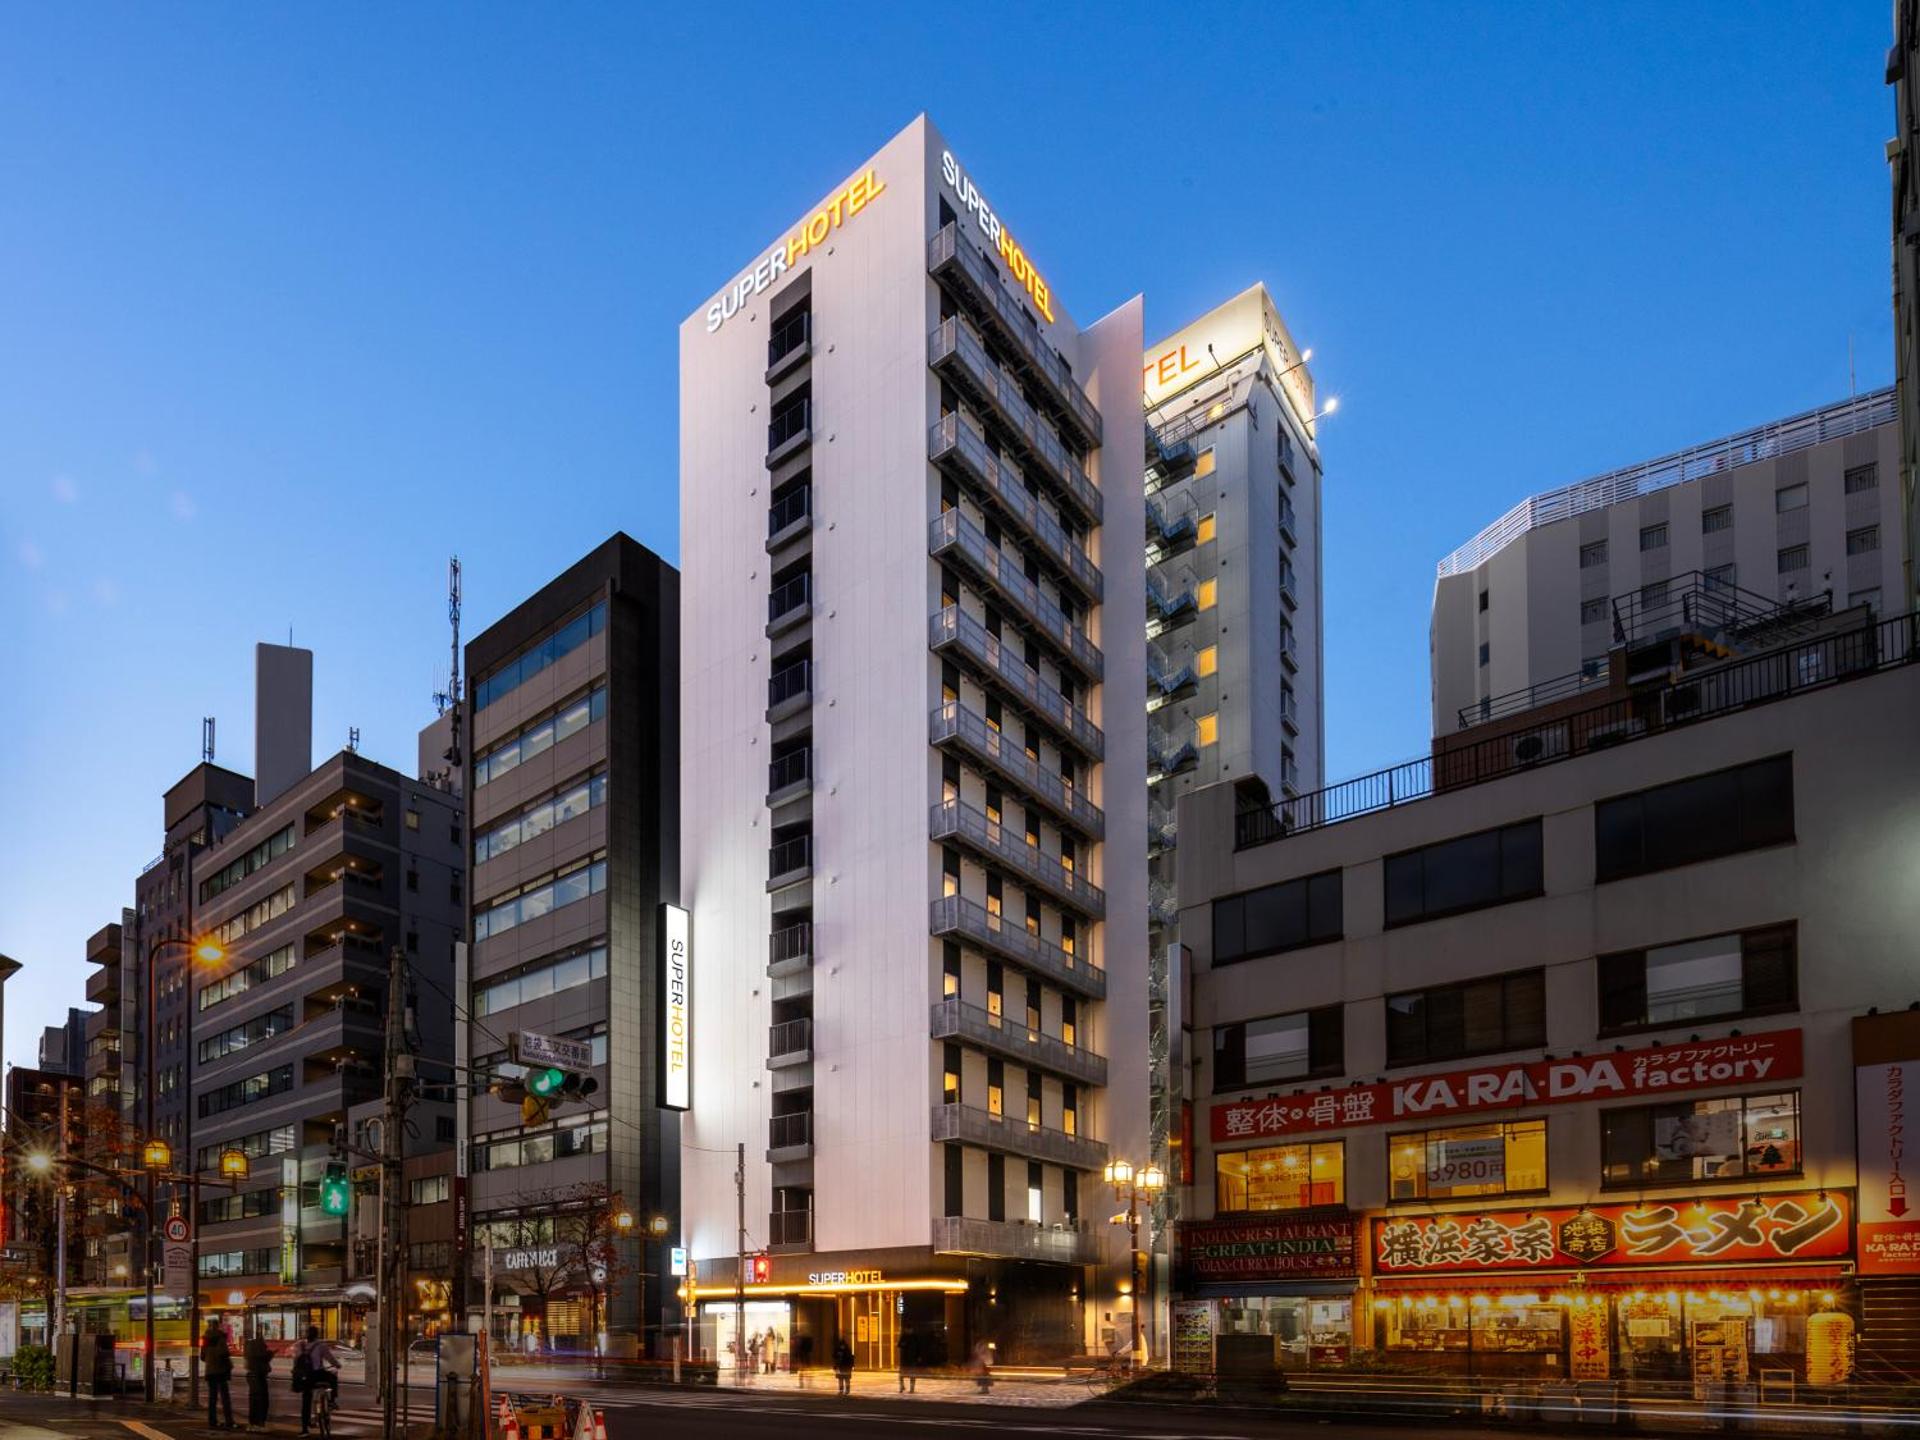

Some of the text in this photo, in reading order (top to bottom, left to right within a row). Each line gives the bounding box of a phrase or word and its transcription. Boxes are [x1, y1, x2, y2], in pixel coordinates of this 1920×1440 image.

[706, 168, 886, 333] SUPERHOTEL
[942, 150, 1055, 324] SUPERHOTEL
[671, 938, 684, 1073] SUPERHOTEL
[1632, 1056, 1775, 1090] factory
[171, 1223, 185, 1236] 40
[1379, 1199, 1843, 1269] 横浜家系 ラーメン
[808, 1270, 886, 1286] SUPERHOTEL
